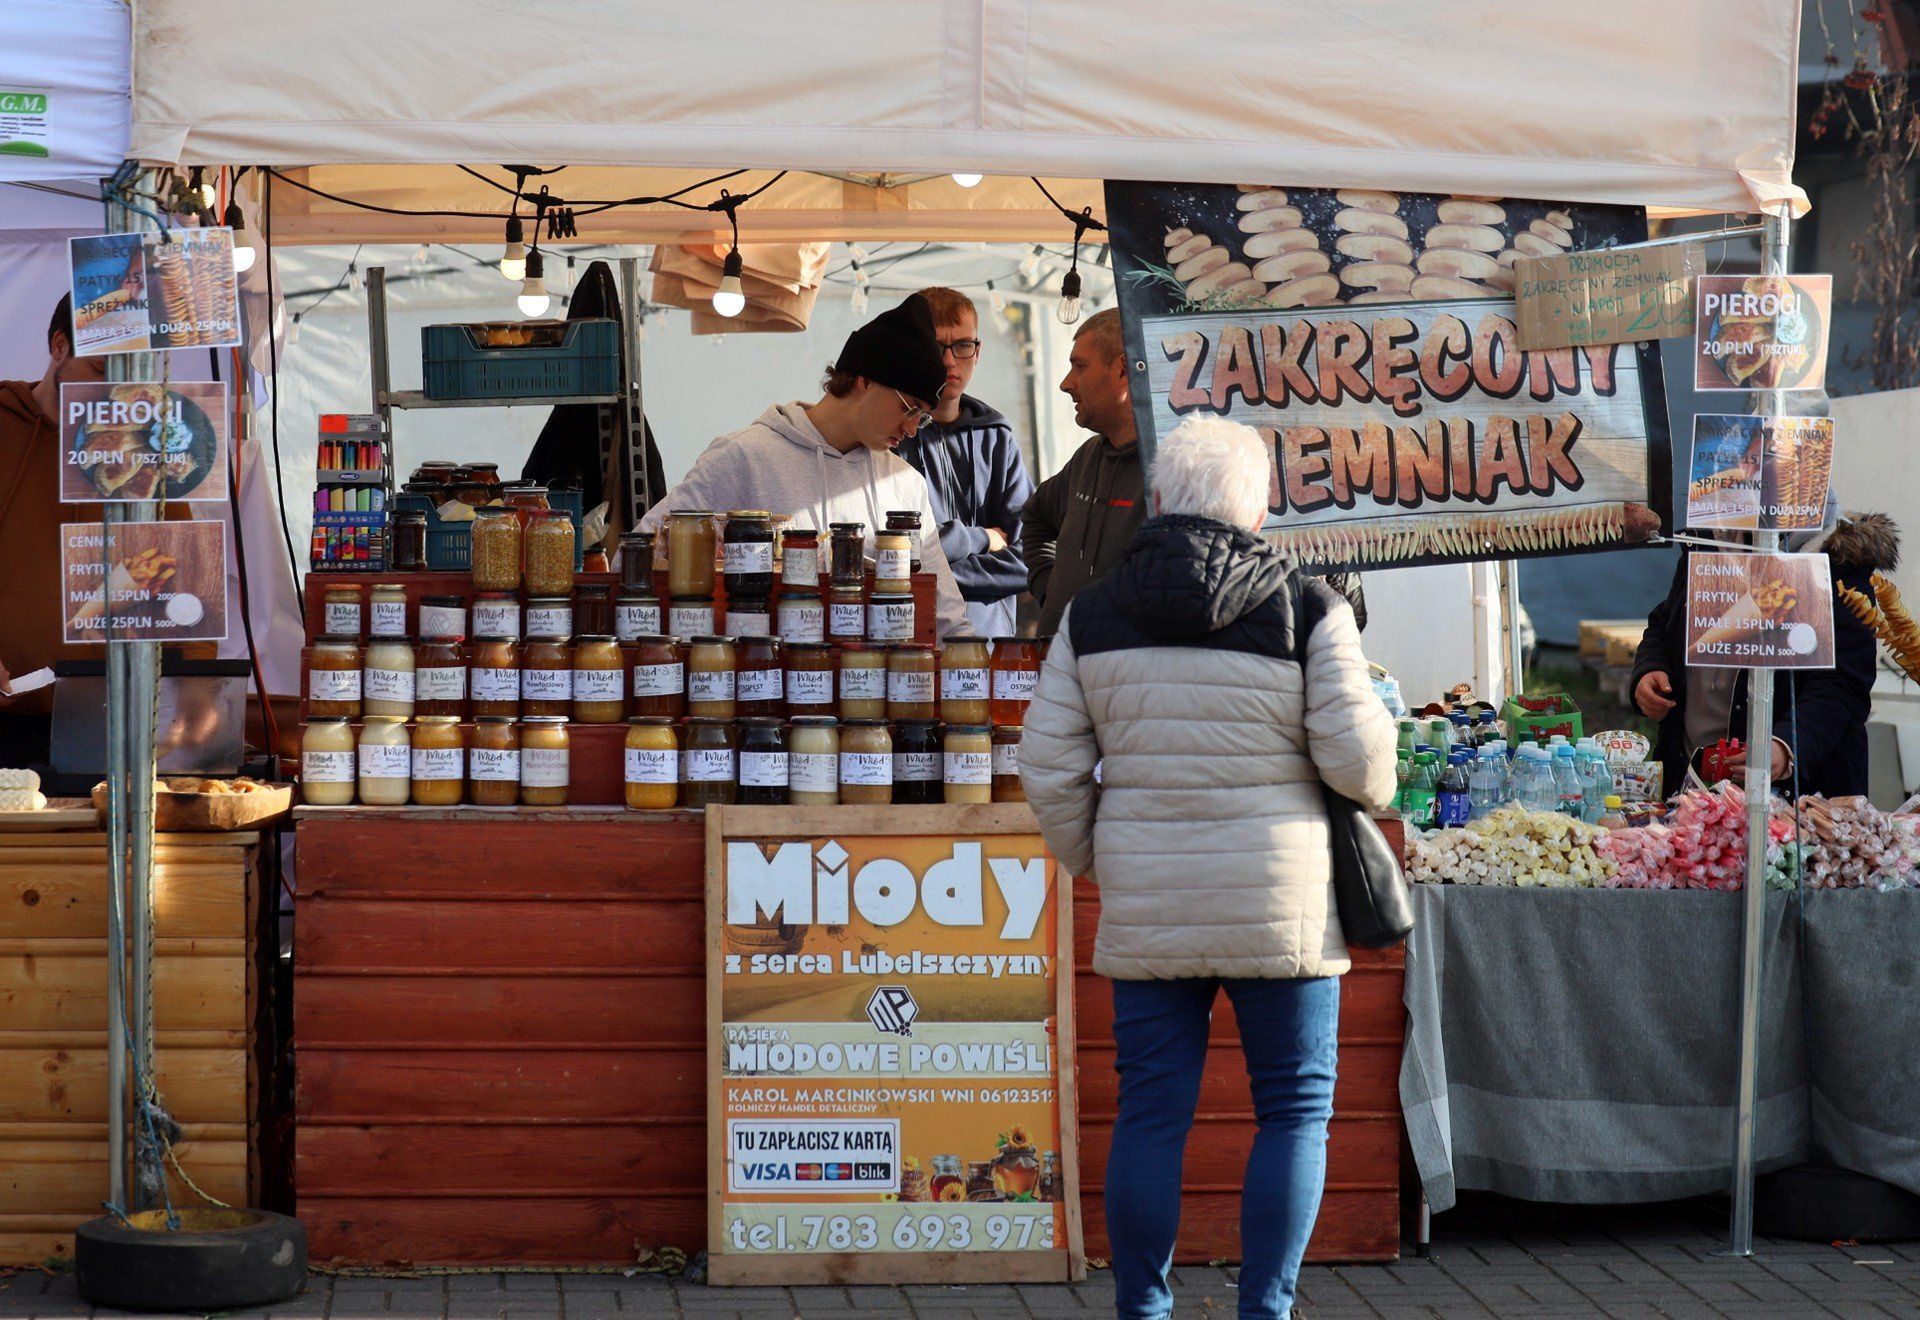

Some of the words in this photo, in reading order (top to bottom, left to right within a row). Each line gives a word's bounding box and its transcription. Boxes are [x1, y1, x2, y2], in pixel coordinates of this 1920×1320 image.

[1566, 253, 1640, 274] PROMOCJA
[79, 275, 121, 287] PATYK
[126, 272, 140, 284] 15
[1704, 293, 1801, 316] PIEROGI
[160, 320, 192, 335] DUŻA
[1702, 341, 1720, 355] 20
[1724, 341, 1753, 355] PLN
[1160, 317, 1620, 417] ZAKRĘCONY
[68, 451, 87, 465] 20
[93, 450, 124, 465] PLN
[1267, 412, 1584, 517] IEMNIAK
[1769, 504, 1793, 516] DUŻA
[1695, 565, 1744, 577] CENNIK
[110, 589, 150, 602] 15PLN
[1695, 591, 1738, 603] FRYTKI
[74, 615, 107, 629] DUŻE
[112, 616, 152, 629] 25PLN
[1694, 616, 1730, 629] MAŁE
[1735, 618, 1774, 631] 15PLN
[1696, 640, 1731, 654] DUŻE
[1735, 644, 1775, 656] 25PLN
[727, 838, 1057, 940] Miody
[725, 954, 743, 975] z
[751, 953, 833, 975] serca
[842, 950, 1055, 979] Lubelszczyzny
[728, 1028, 792, 1041] PASIEKA
[728, 1042, 901, 1072] MIODOWE
[910, 1038, 1052, 1073] POWIŚL
[728, 1087, 789, 1103] KAROL
[795, 1087, 935, 1103] MARCINKOWSKI
[941, 1087, 975, 1103] WNI
[728, 1103, 777, 1112] ROLNICZY
[779, 1103, 816, 1112] HANDEL
[819, 1103, 878, 1112] DETALICZNY
[736, 1131, 755, 1151] TU
[759, 1131, 840, 1151] ZAPŁACISZ
[844, 1131, 893, 1154] KARTĄ
[742, 1163, 792, 1181] VISA
[859, 1165, 885, 1179] blik
[892, 1213, 971, 1251] 693
[985, 1213, 1054, 1251] 973
